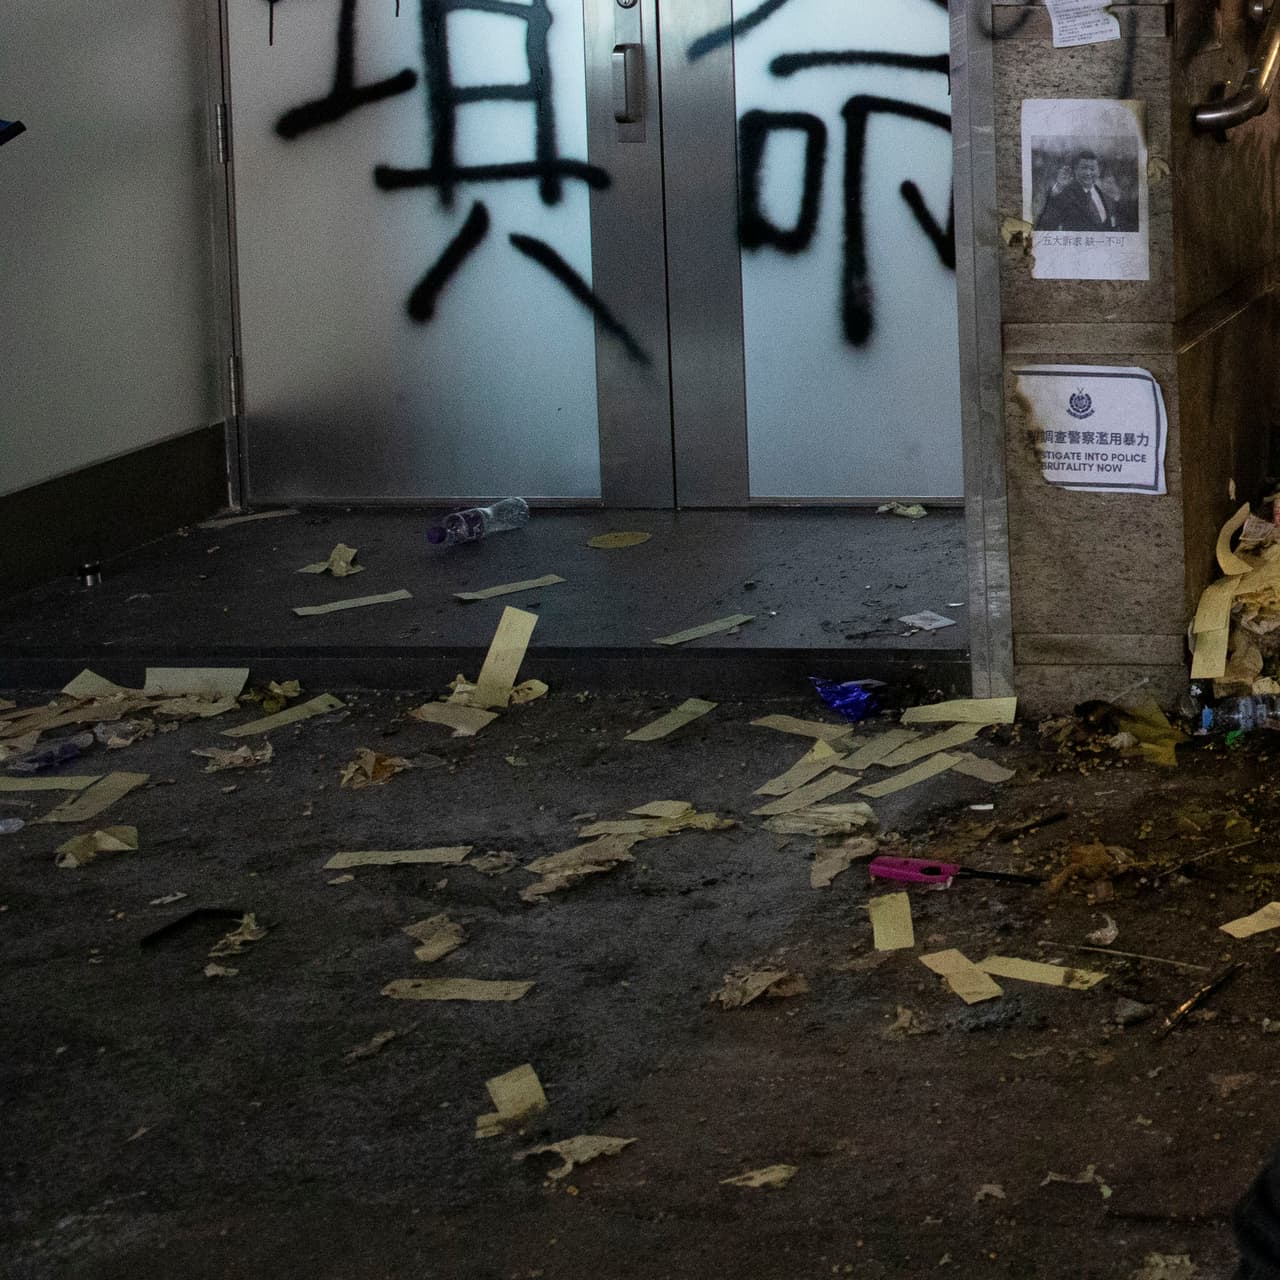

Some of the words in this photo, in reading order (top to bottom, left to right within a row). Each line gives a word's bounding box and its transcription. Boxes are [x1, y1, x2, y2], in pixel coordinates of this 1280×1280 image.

[1042, 234, 1084, 248] 五大訴求
[1084, 452, 1109, 462] INTO
[1111, 452, 1148, 463] POLICE
[1041, 462, 1095, 472] BRUTALITY
[1097, 463, 1123, 473] NOW
